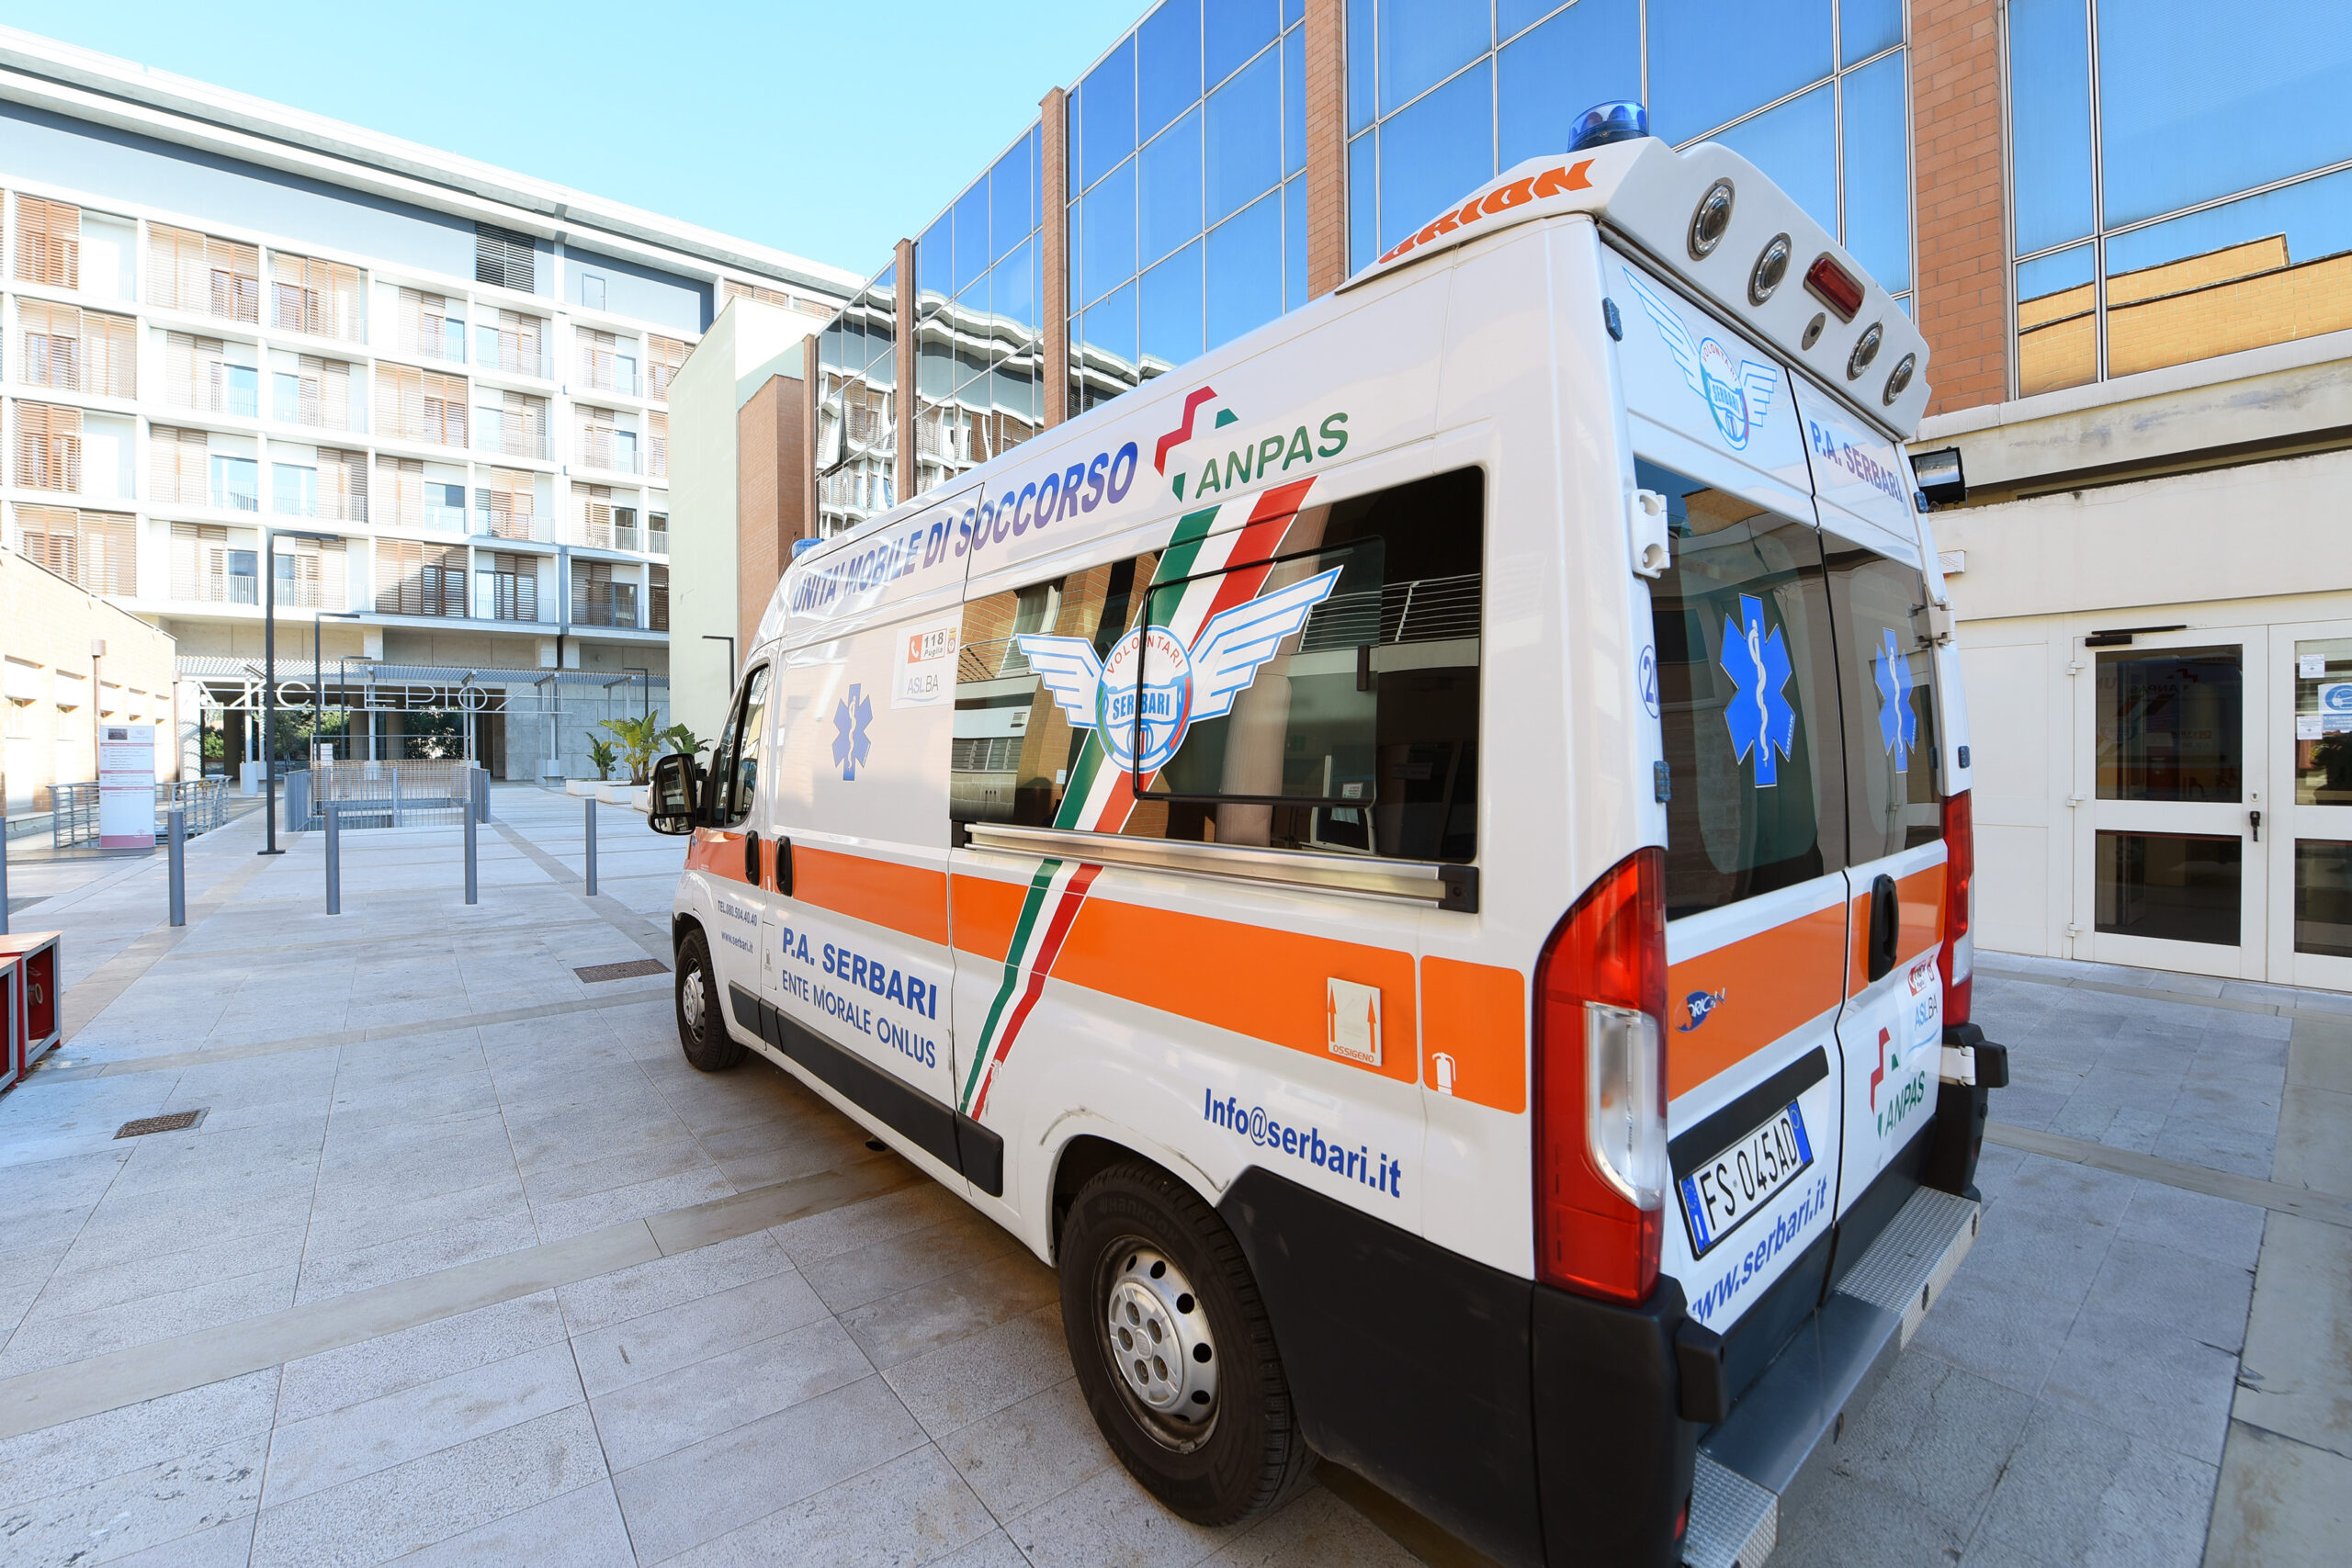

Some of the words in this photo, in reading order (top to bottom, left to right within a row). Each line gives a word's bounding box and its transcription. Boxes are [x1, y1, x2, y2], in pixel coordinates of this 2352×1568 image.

[1378, 158, 1596, 265] ORION
[1712, 384, 1741, 415] SERBARI
[1195, 412, 1350, 499] ANPAS
[1809, 420, 1843, 467] P.A.
[1843, 442, 1904, 503] SERBARI
[843, 529, 923, 596] MOBILE
[922, 516, 954, 570] DI
[956, 441, 1138, 557] SOCCORSO
[923, 632, 944, 649] 118
[924, 647, 944, 657] Puglia
[1106, 635, 1184, 674] VOLONTARI
[1112, 693, 1170, 721] SERBARI
[721, 931, 753, 954] www.serbari.it
[782, 927, 815, 966] P.A.
[822, 942, 937, 1021] SERBARI
[782, 969, 809, 1003] ENTE
[813, 984, 872, 1036] MORALE
[876, 1017, 936, 1069] ONLUS
[1332, 1044, 1374, 1063] OSSIGENO
[1884, 1070, 1926, 1137] ANPAS
[1204, 1088, 1402, 1199] Info@serbari.it
